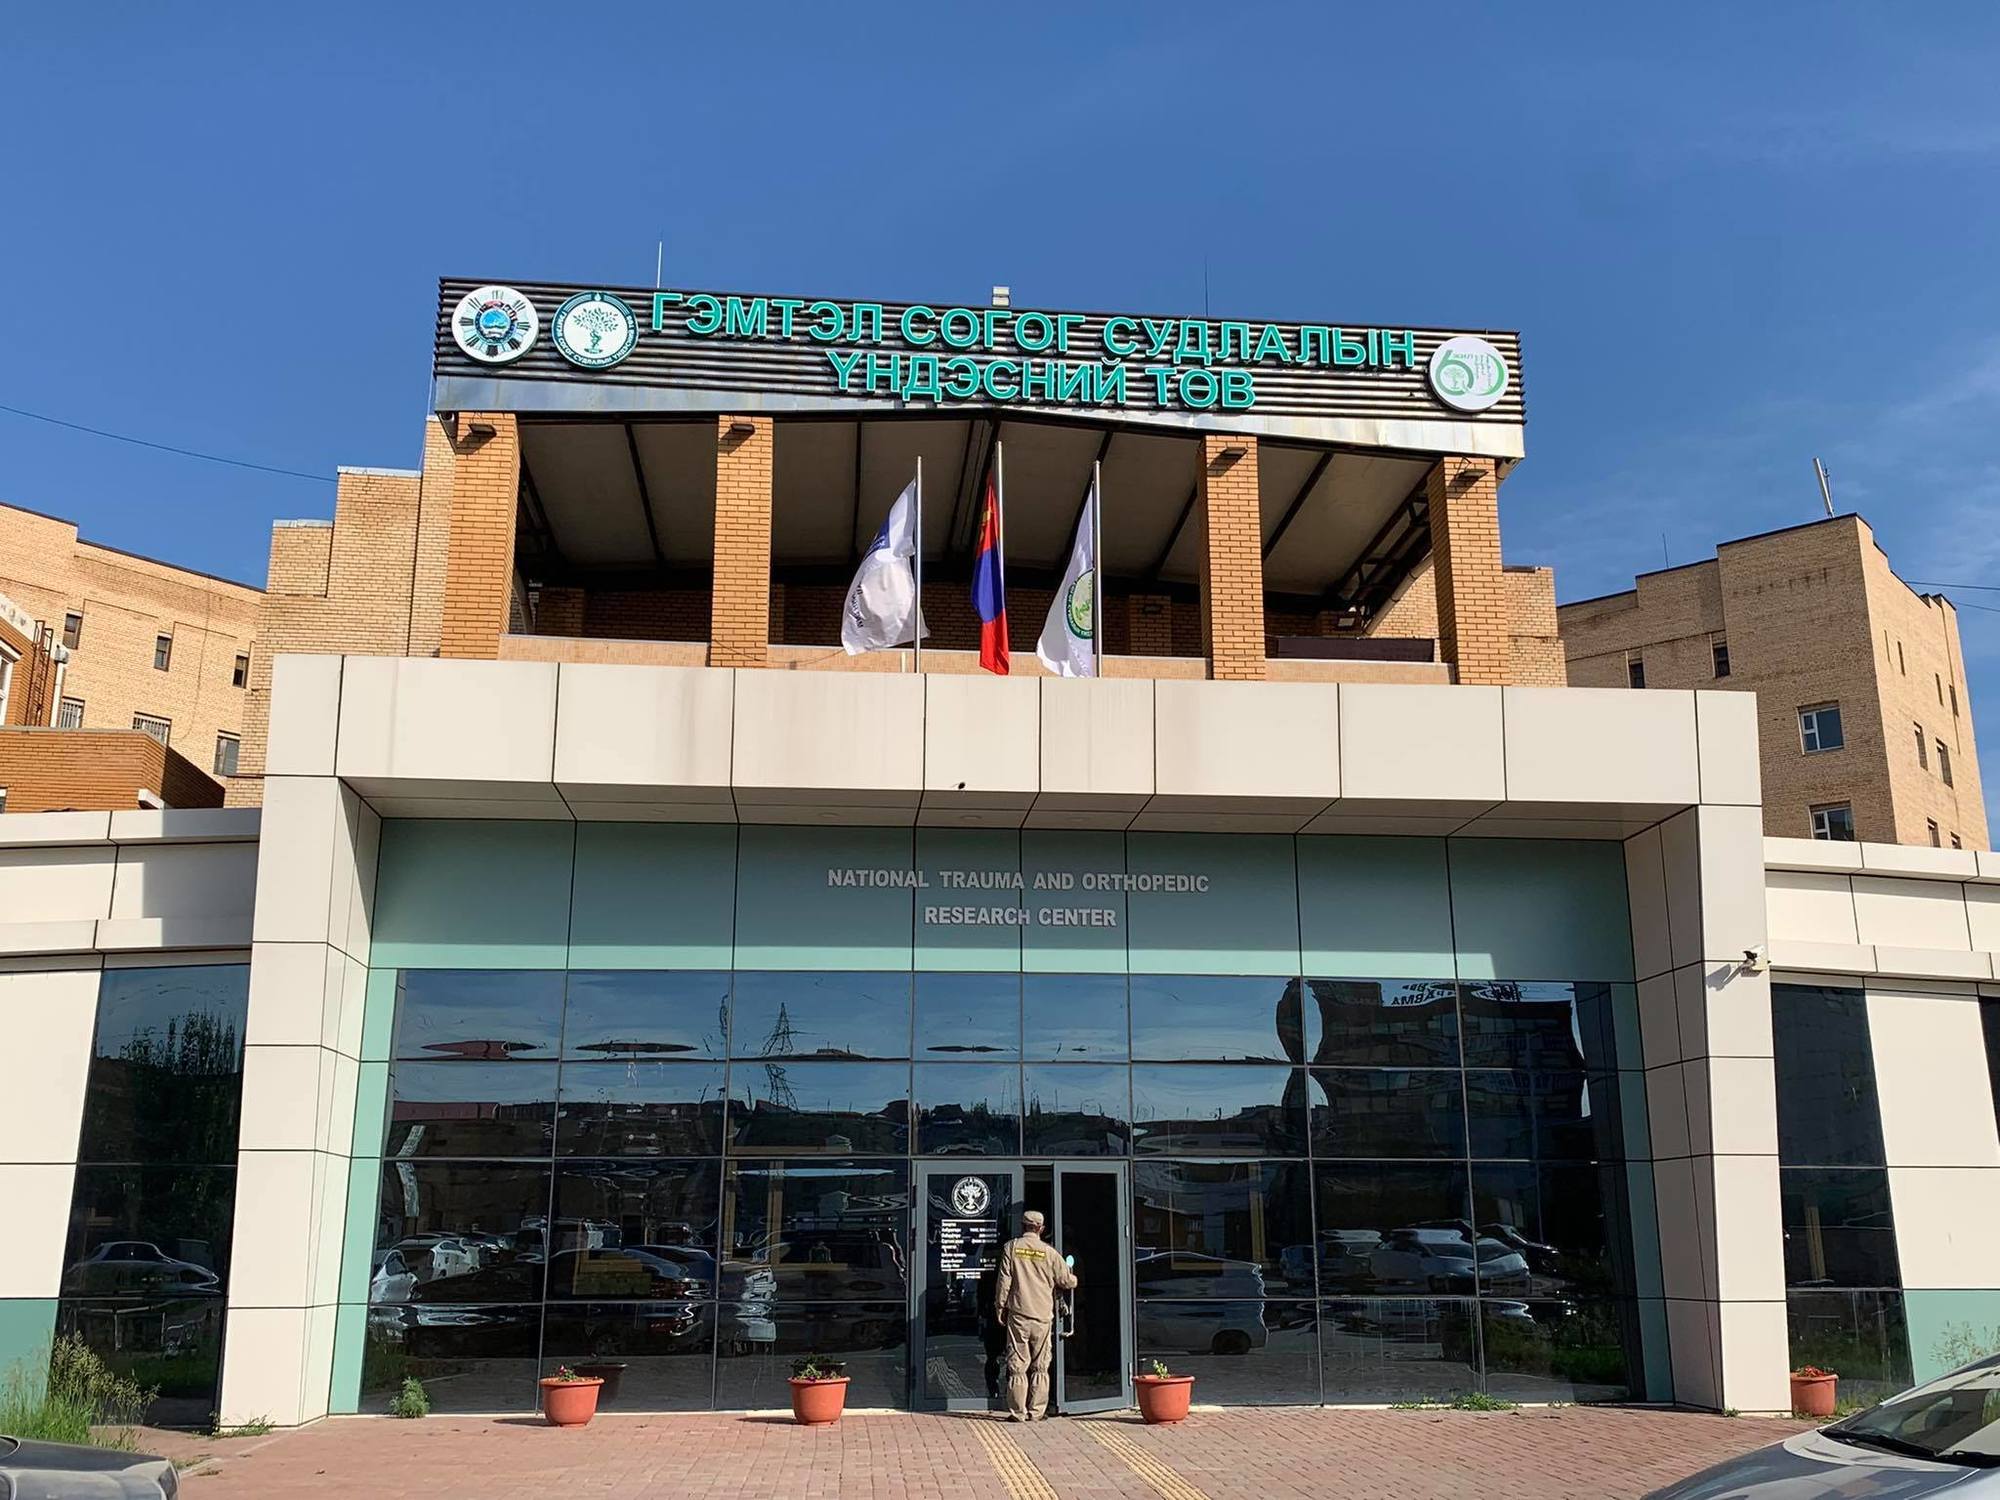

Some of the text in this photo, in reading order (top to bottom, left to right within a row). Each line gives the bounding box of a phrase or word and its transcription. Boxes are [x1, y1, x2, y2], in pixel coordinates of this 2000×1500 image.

[652, 292, 1415, 367] ГЭМТЭЛ СОГОГ СУДЛАЛЫН
[825, 349, 1256, 408] ҮНДЭСНИЙ ТӨВ
[827, 869, 1209, 892] NATIONAL TRAUMA AND ORTHOPEDIC
[924, 906, 1117, 926] RESEARCH CENTER
